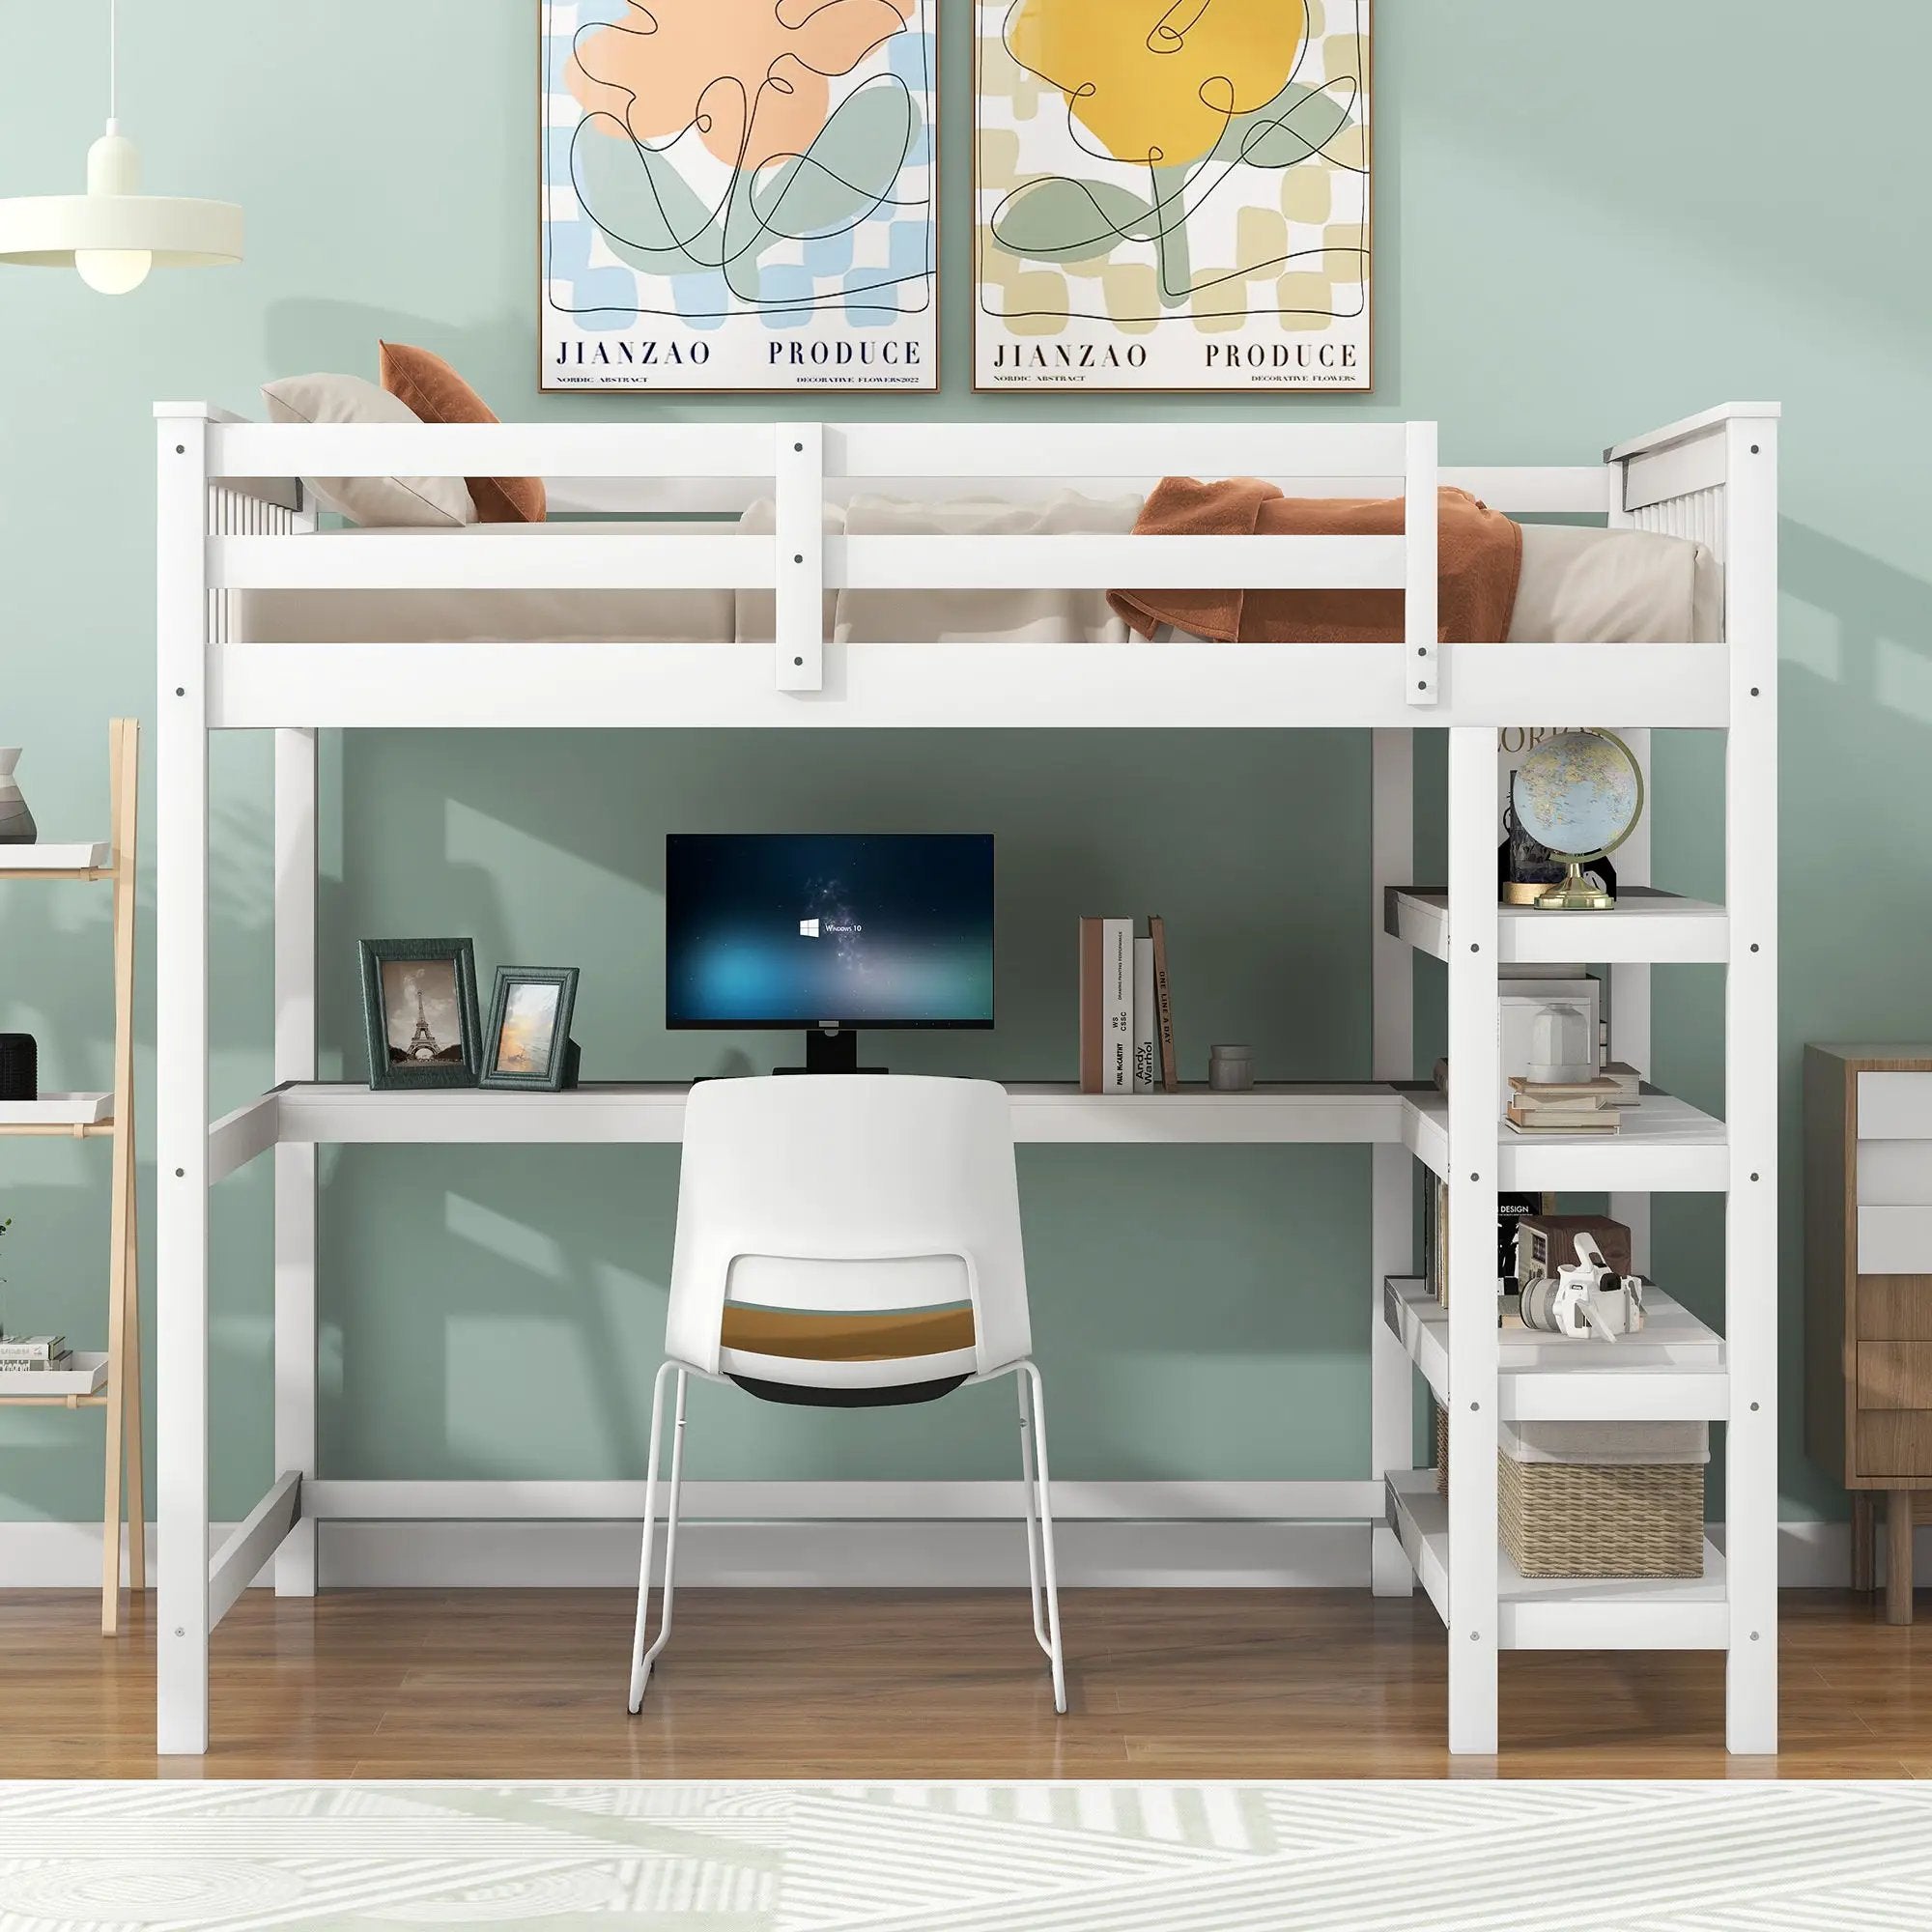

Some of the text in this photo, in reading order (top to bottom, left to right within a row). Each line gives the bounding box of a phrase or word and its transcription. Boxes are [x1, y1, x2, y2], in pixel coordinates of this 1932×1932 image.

[555, 341, 921, 365] JIANZAO PRODUCE
[993, 344, 1357, 368] JIANZAO PRODUCE
[1112, 1016, 1119, 1028] WS
[1135, 1045, 1147, 1080] Andy
[1144, 1041, 1152, 1086] Warhol
[1500, 1205, 1529, 1213] DESIGN
